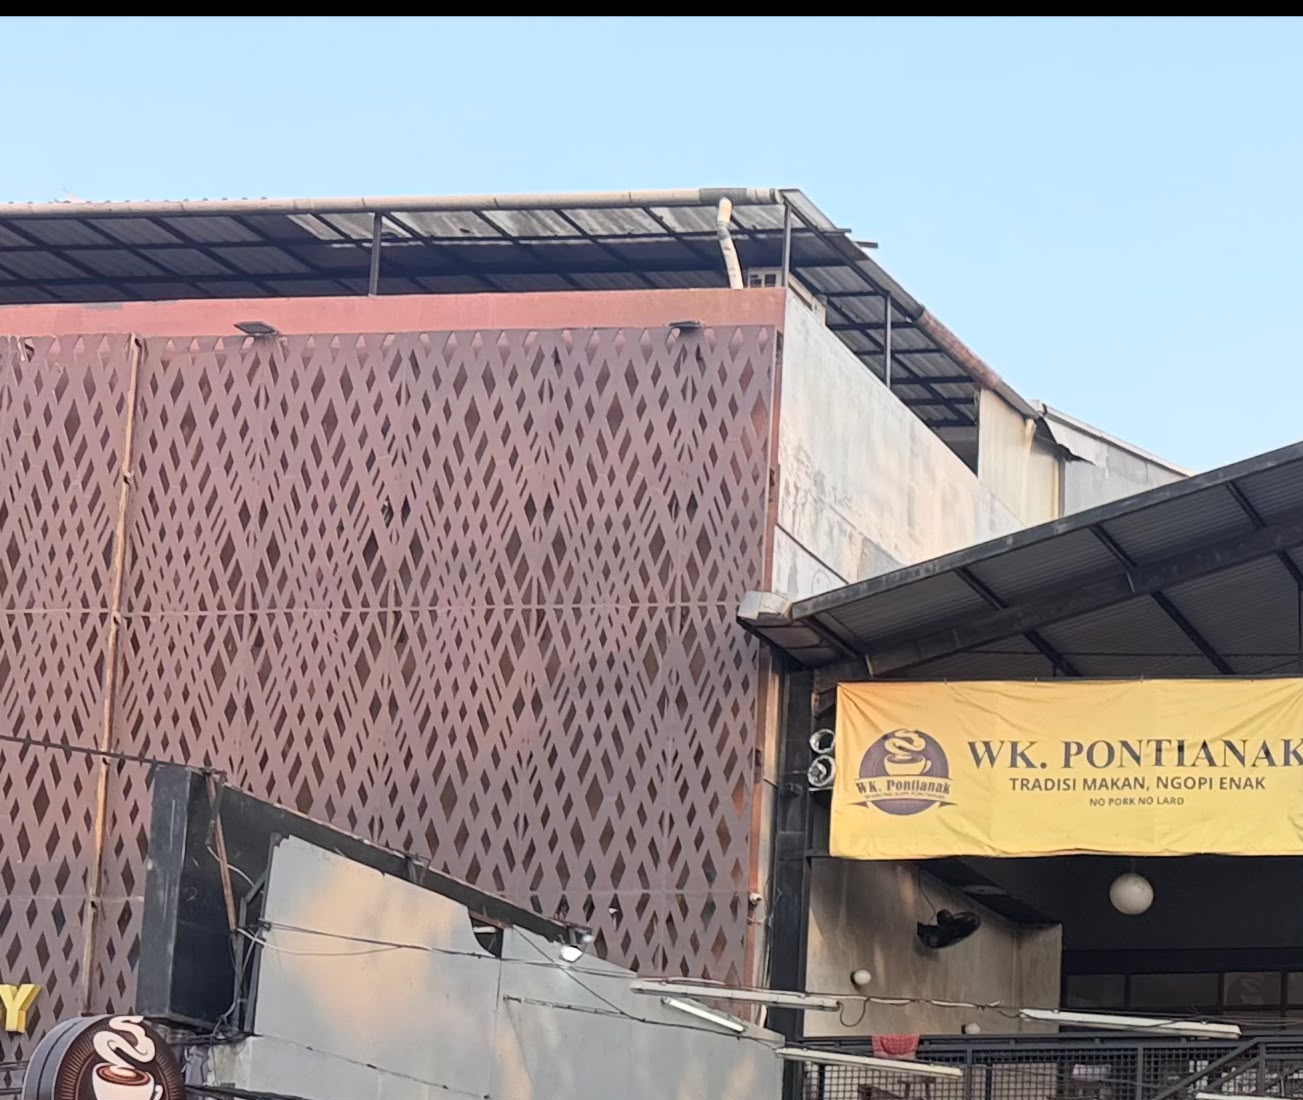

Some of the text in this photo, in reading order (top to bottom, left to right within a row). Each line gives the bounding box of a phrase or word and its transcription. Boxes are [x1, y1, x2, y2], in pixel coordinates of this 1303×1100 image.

[967, 740, 1048, 769] WK.
[1009, 776, 1266, 792] TRADISI MAKAN, NGOPI ENAK
[1089, 796, 1185, 807] NO PORK NO LARD
